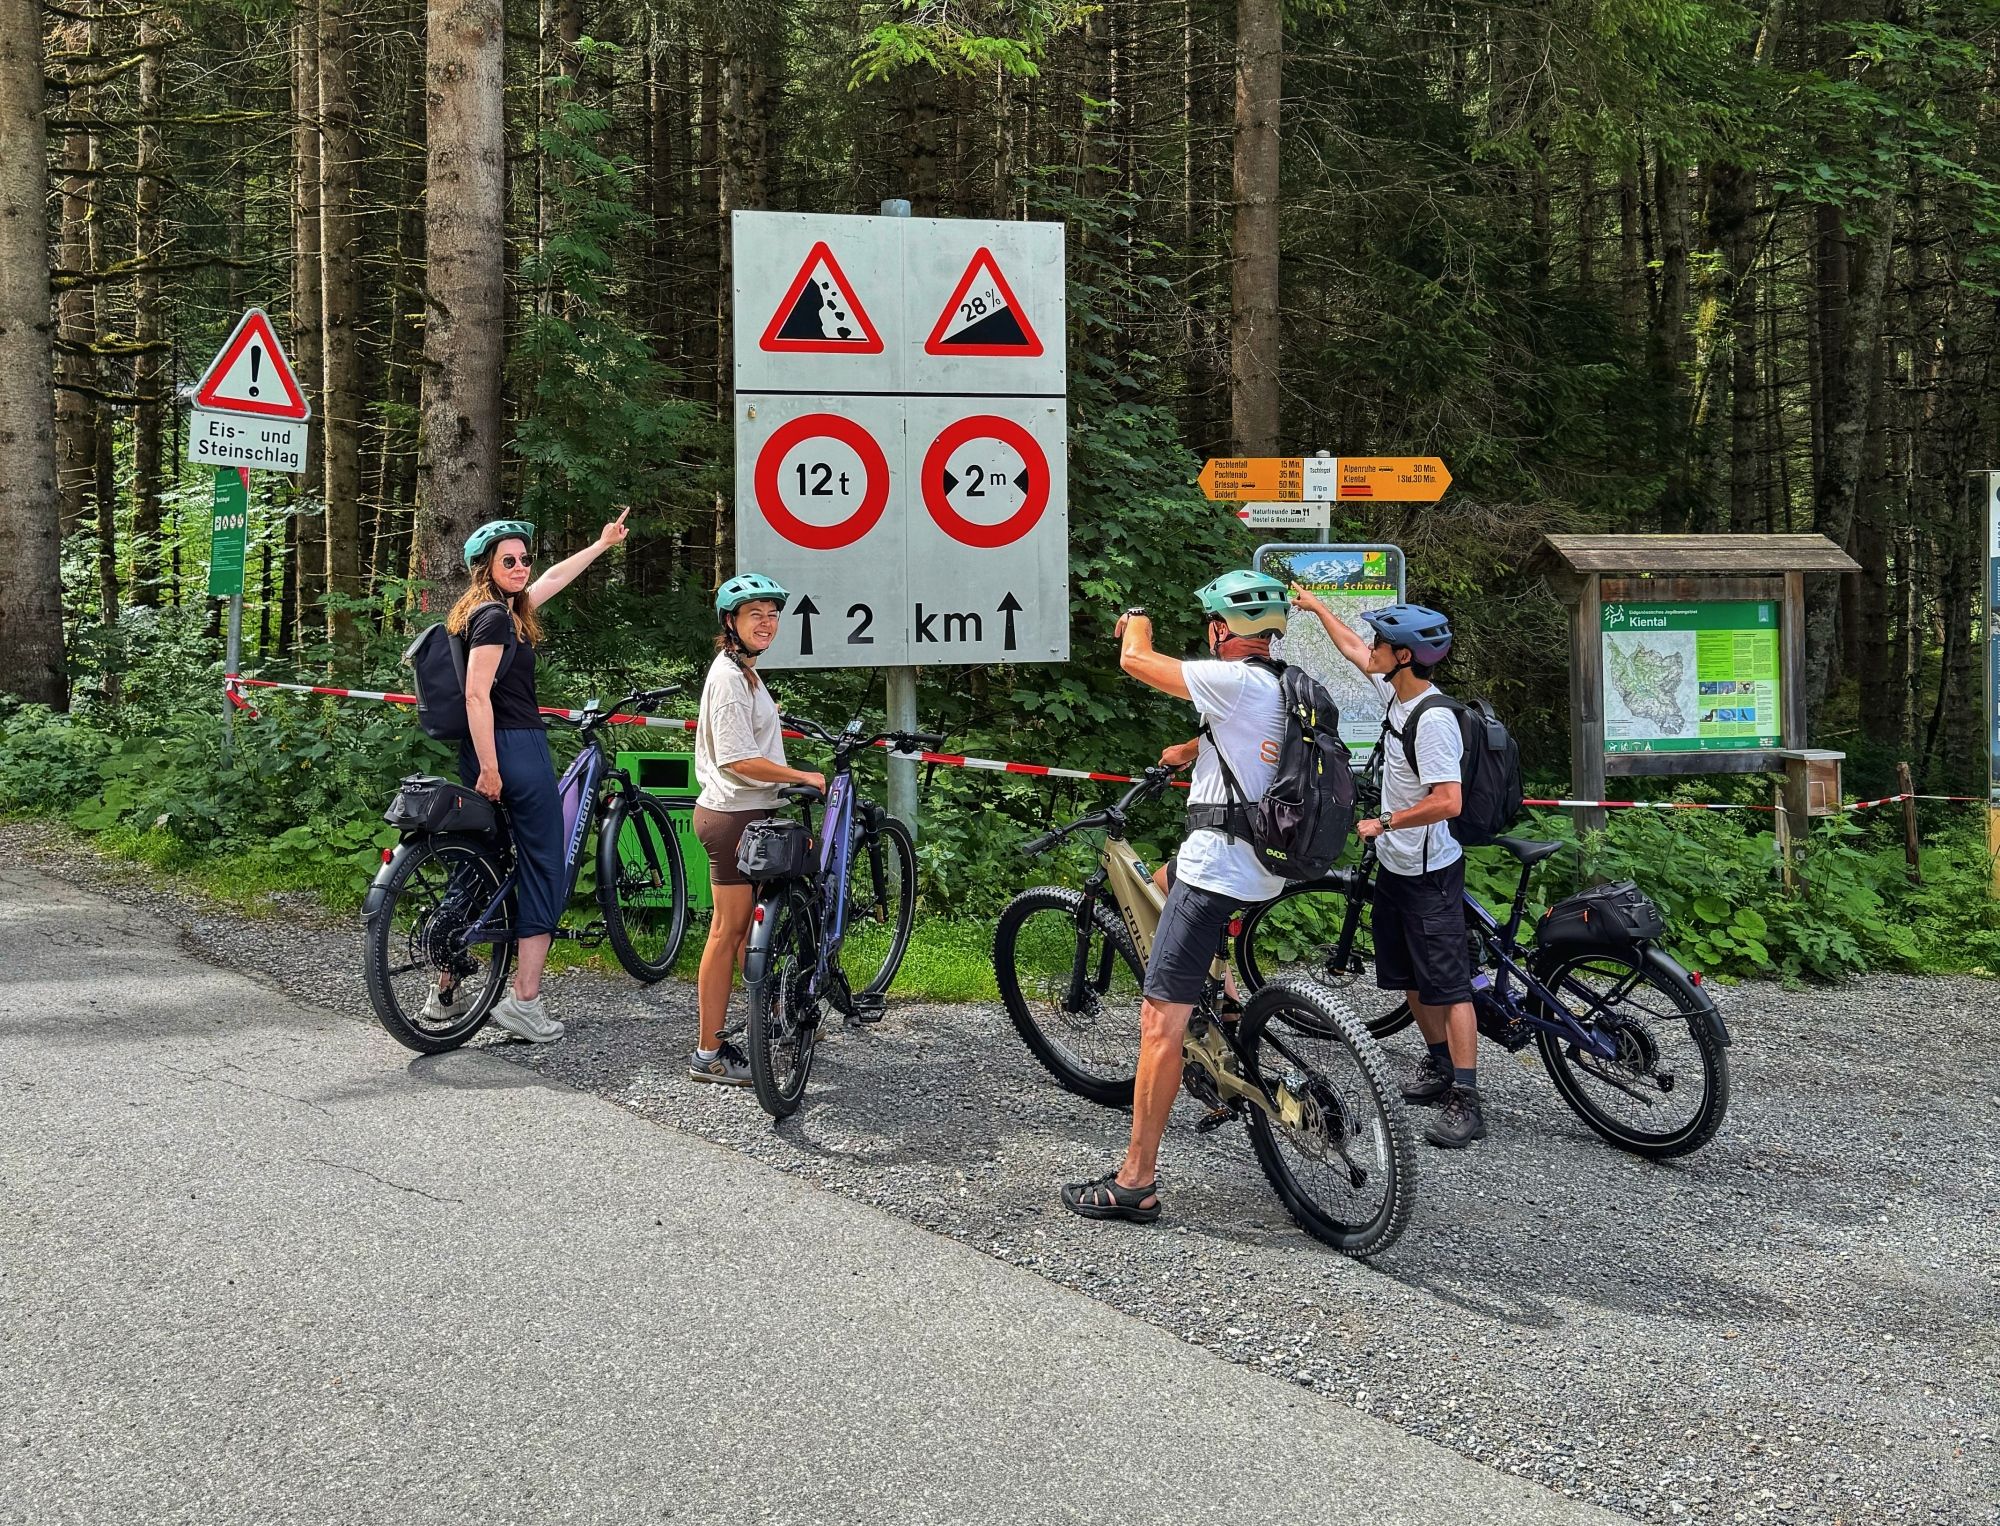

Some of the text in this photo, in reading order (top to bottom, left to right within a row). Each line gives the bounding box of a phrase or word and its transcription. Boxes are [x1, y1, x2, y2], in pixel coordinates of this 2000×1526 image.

[209, 421, 291, 444] Eis- und
[198, 439, 299, 468] Steinschlag
[1214, 460, 1301, 469] Pochtenfall 15 Min.
[1343, 464, 1437, 474] Alpenruhe 30 Min.
[1214, 471, 1248, 479] Pochtenalp
[1343, 474, 1367, 483] Kiental
[1423, 474, 1437, 483] Min.
[1214, 481, 1239, 489] Griesalp
[1288, 481, 1301, 489] Min.
[1343, 581, 1392, 590] Schweiz
[846, 603, 982, 644] 2 km
[1629, 616, 1667, 627] Kiental
[567, 788, 595, 865] POLYGON
[1124, 905, 1150, 968] POLY
